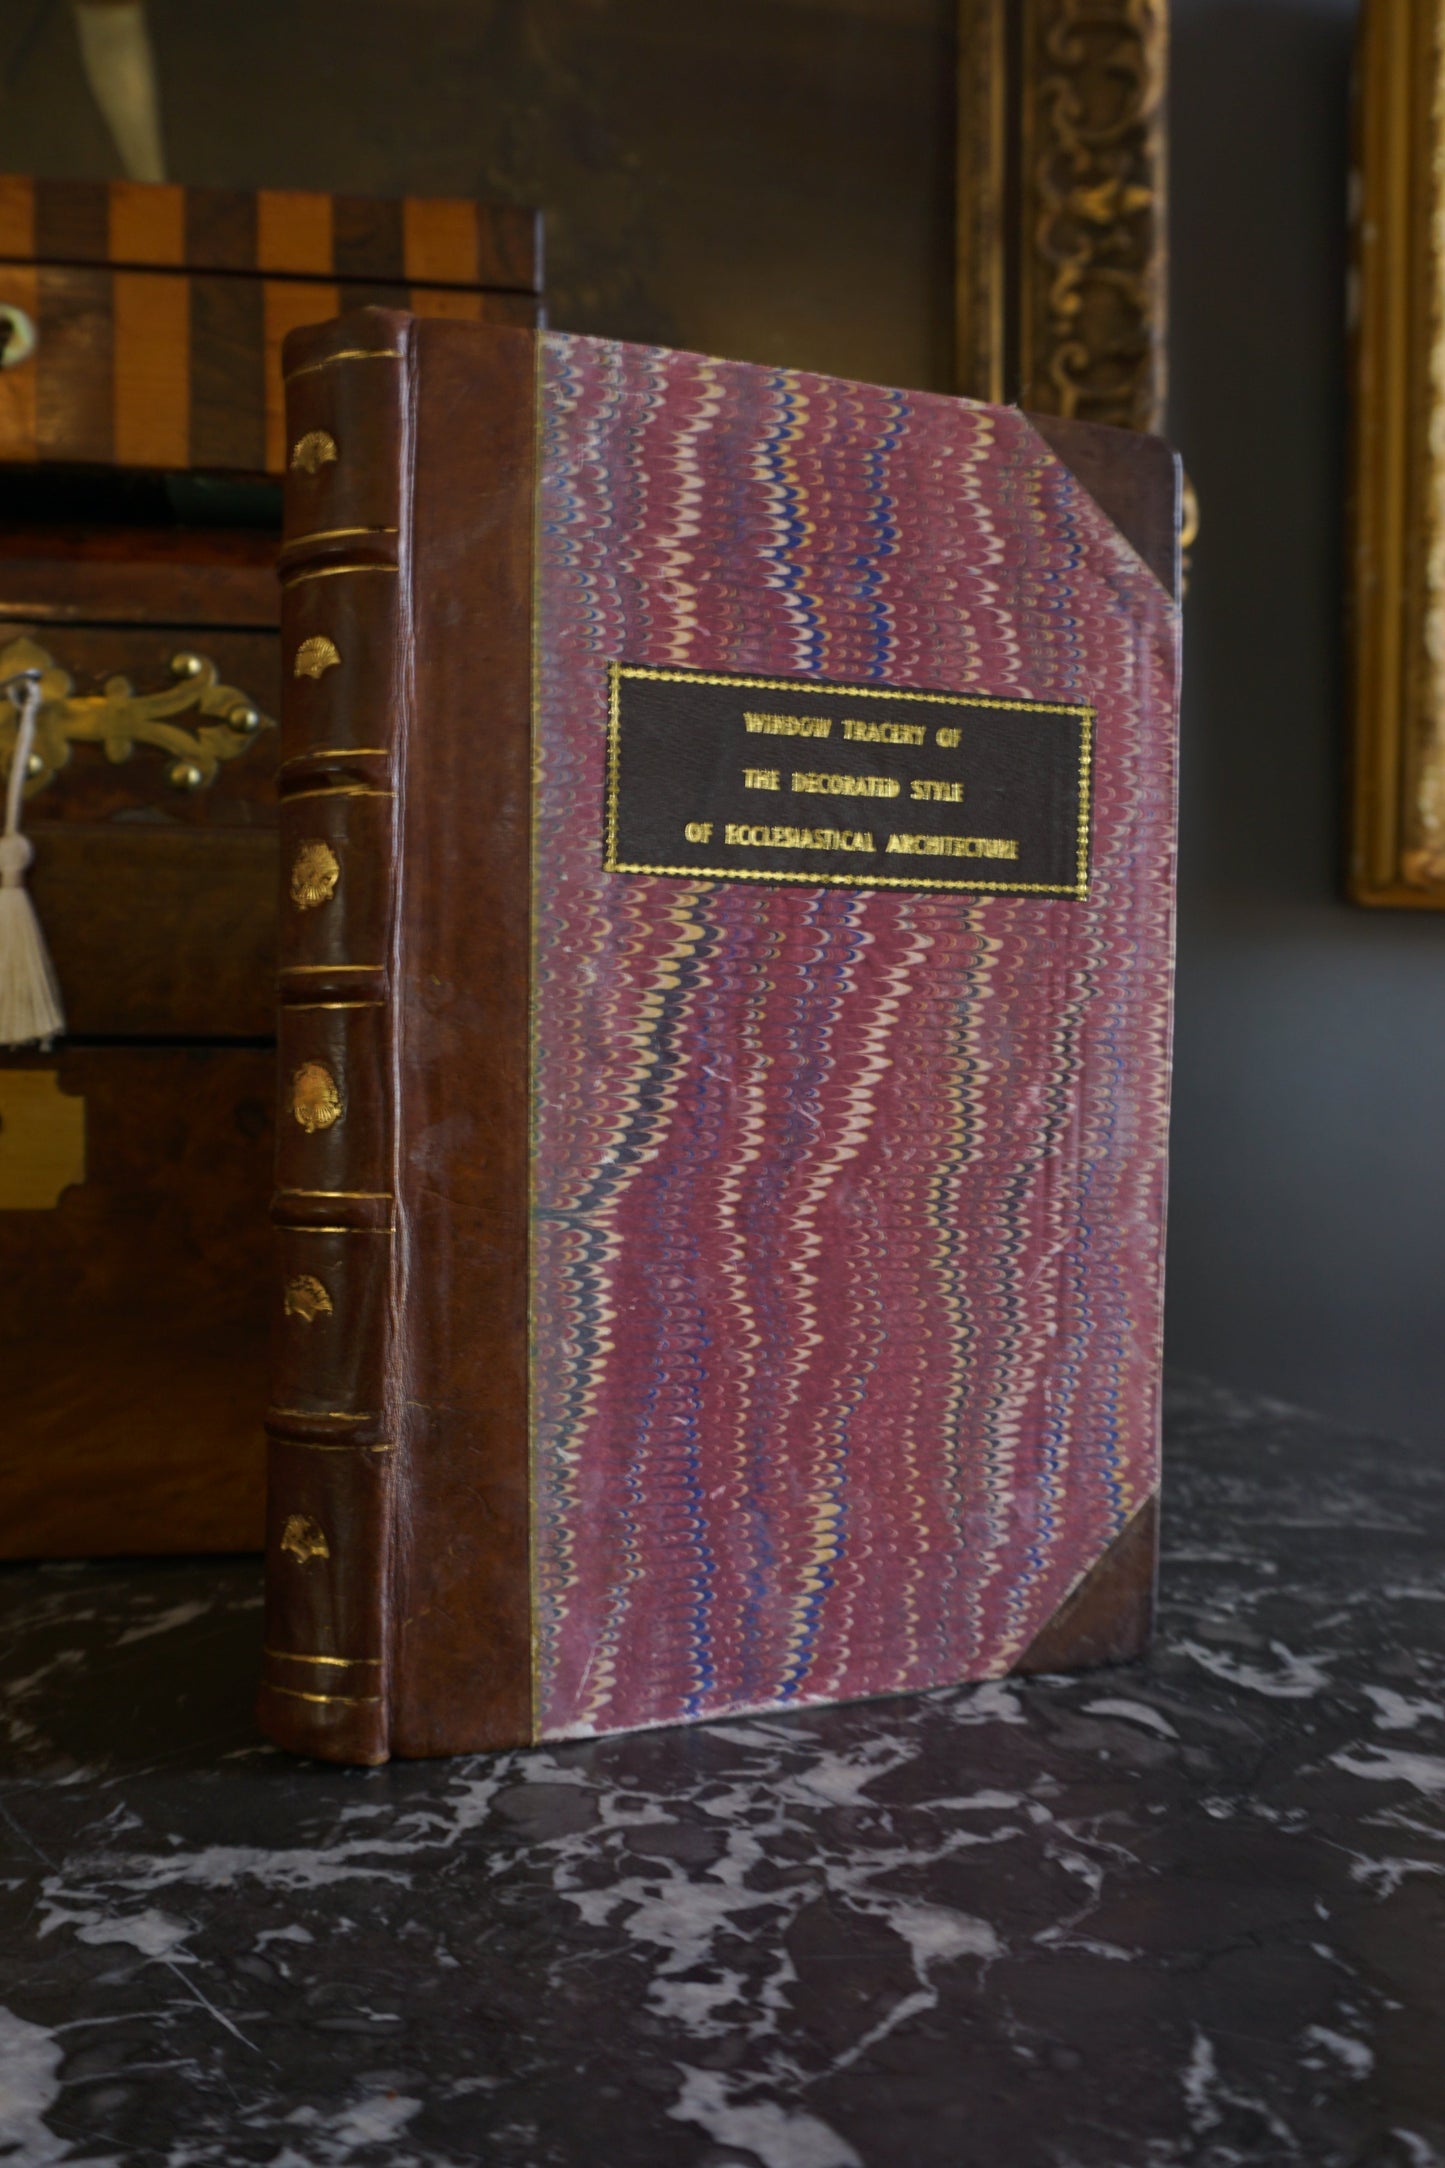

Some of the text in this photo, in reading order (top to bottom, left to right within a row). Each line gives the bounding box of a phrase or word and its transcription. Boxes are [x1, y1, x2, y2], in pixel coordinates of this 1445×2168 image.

[743, 711, 963, 749] WINDOW TRACERY OF
[742, 767, 965, 803] THE DECORATED STYLE
[684, 821, 714, 844] OF
[885, 832, 1020, 861] ARCHITECTURE
